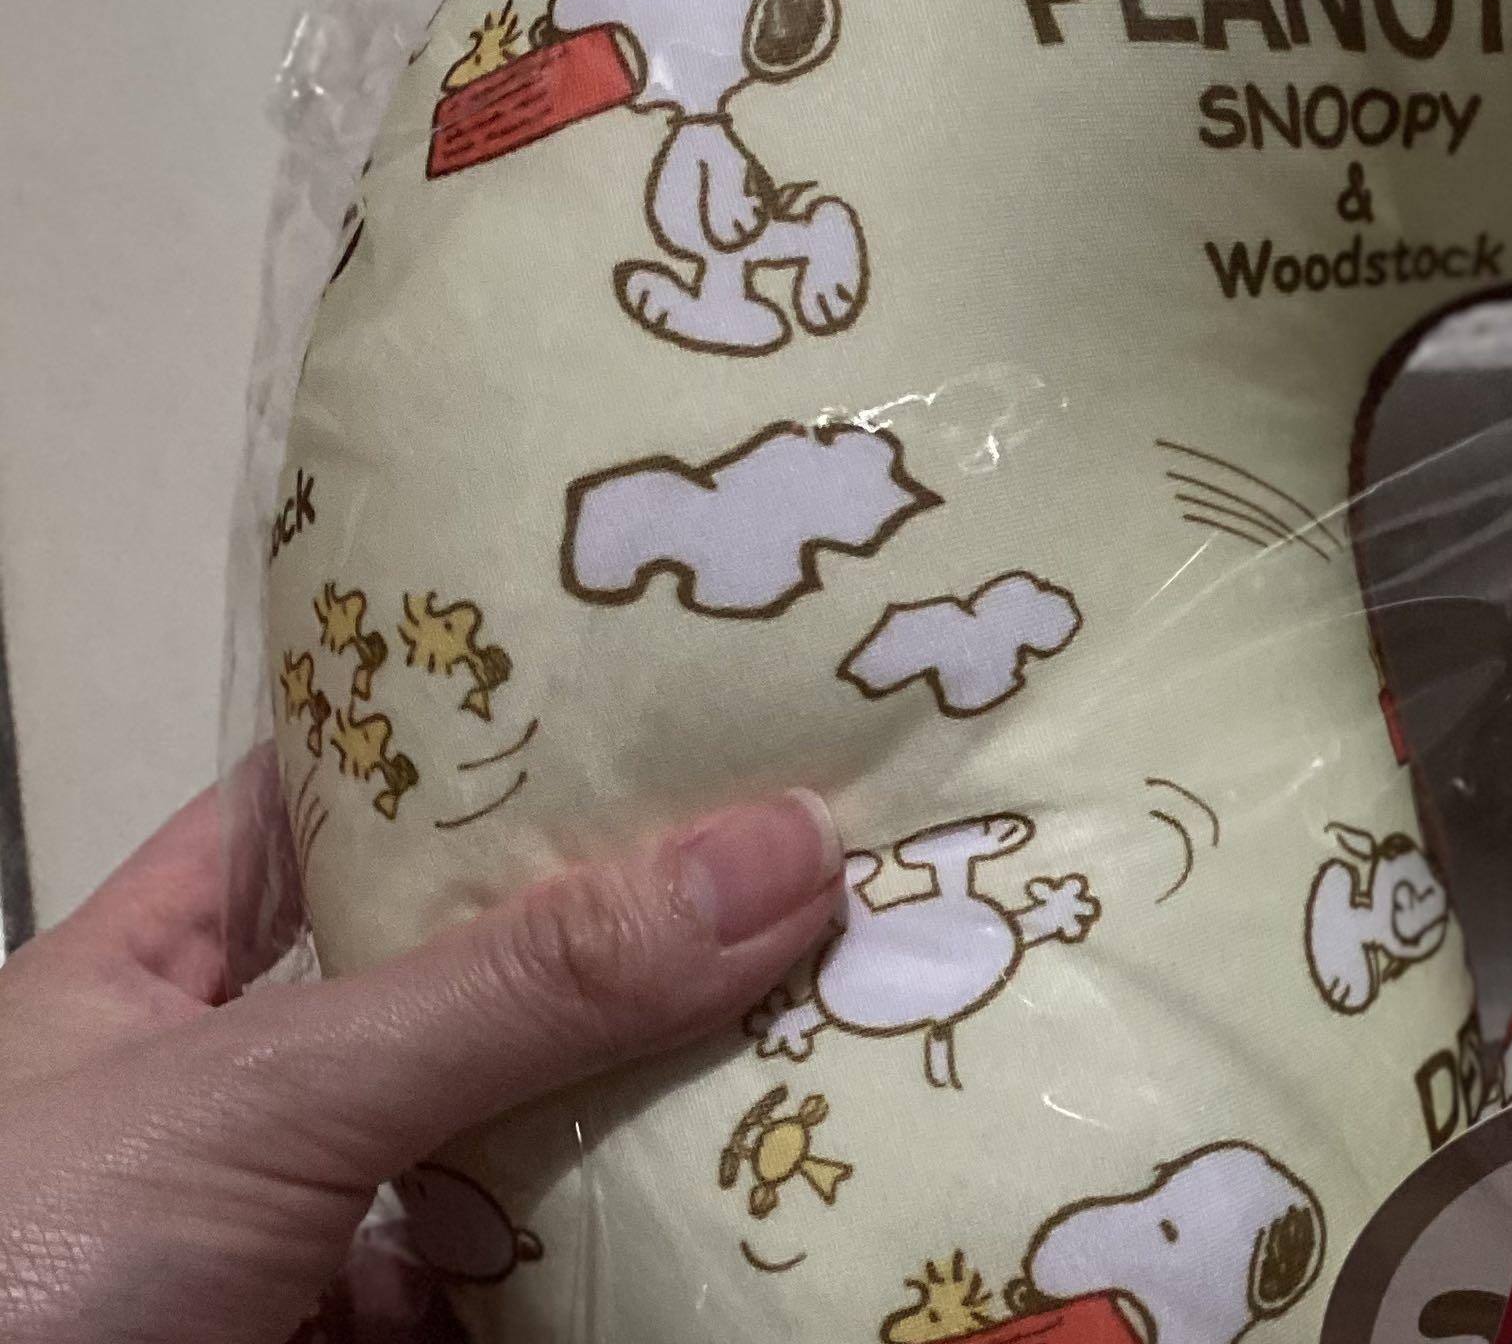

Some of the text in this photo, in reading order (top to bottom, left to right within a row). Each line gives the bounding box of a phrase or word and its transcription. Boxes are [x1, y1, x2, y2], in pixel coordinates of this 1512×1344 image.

[1199, 83, 1482, 154] SNOOPY
[1336, 161, 1373, 223] &
[1204, 232, 1506, 299] Woodstock
